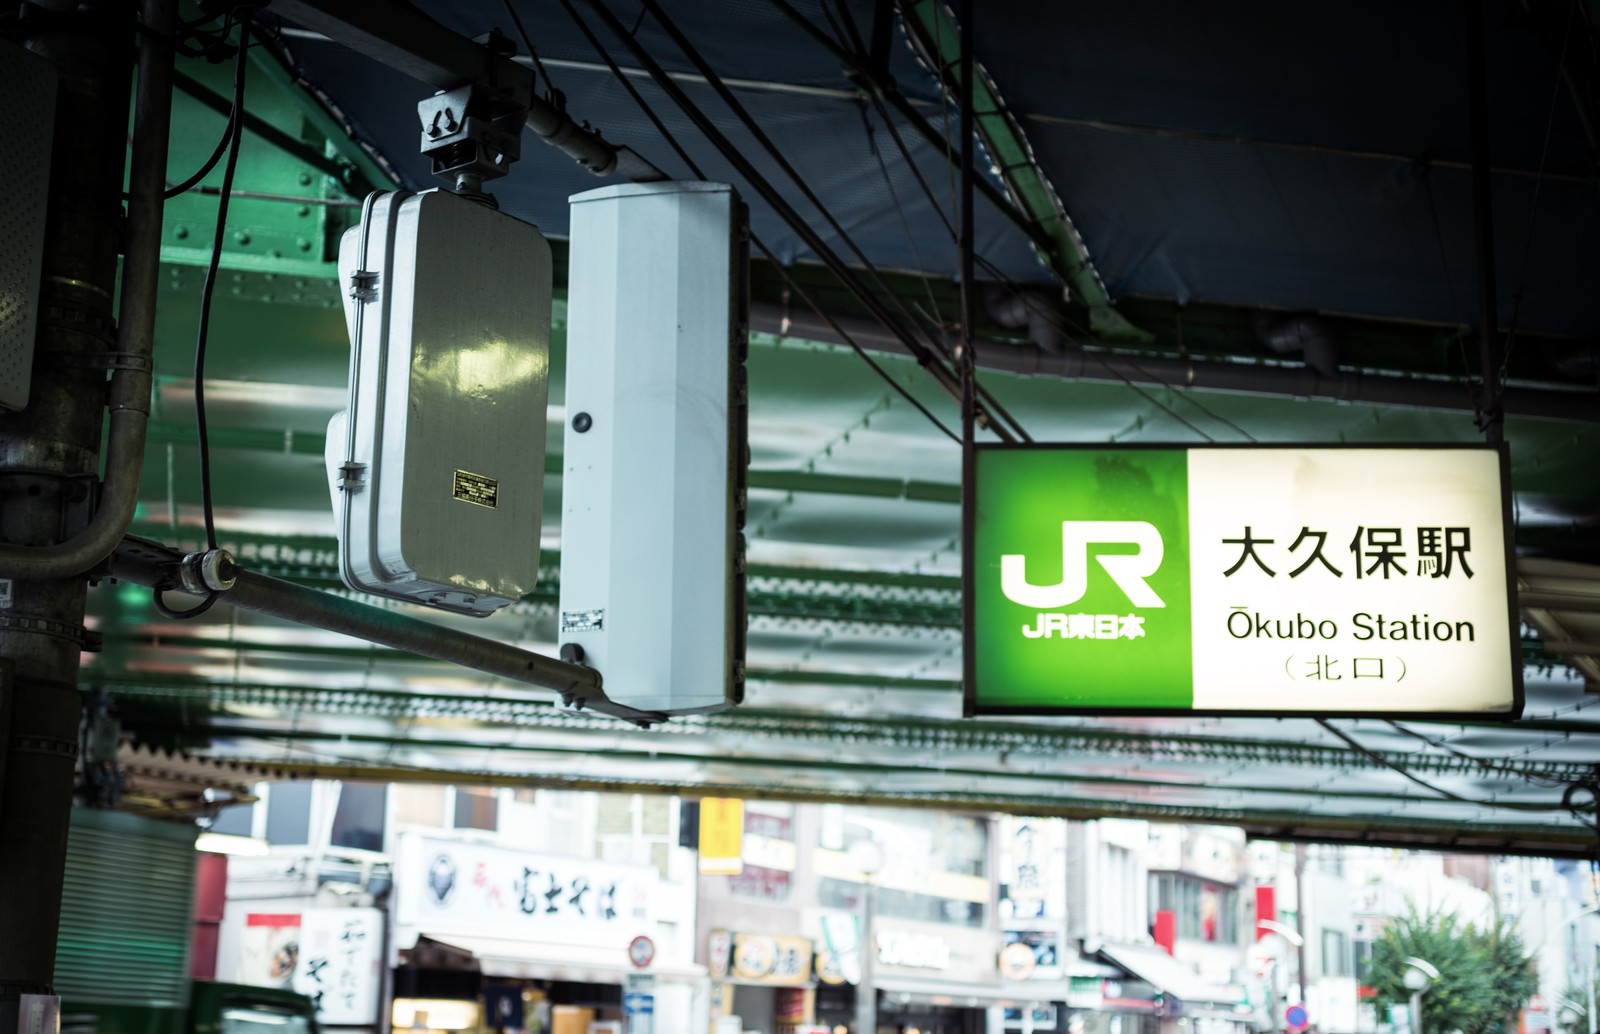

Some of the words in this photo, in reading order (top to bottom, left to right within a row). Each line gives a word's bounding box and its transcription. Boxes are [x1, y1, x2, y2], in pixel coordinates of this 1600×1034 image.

[1001, 521, 1166, 608] JR
[1222, 525, 1475, 580] 大久保駅
[1022, 613, 1146, 641] JR東日本
[1227, 606, 1338, 640] Ōkubo
[1352, 612, 1475, 643] Station
